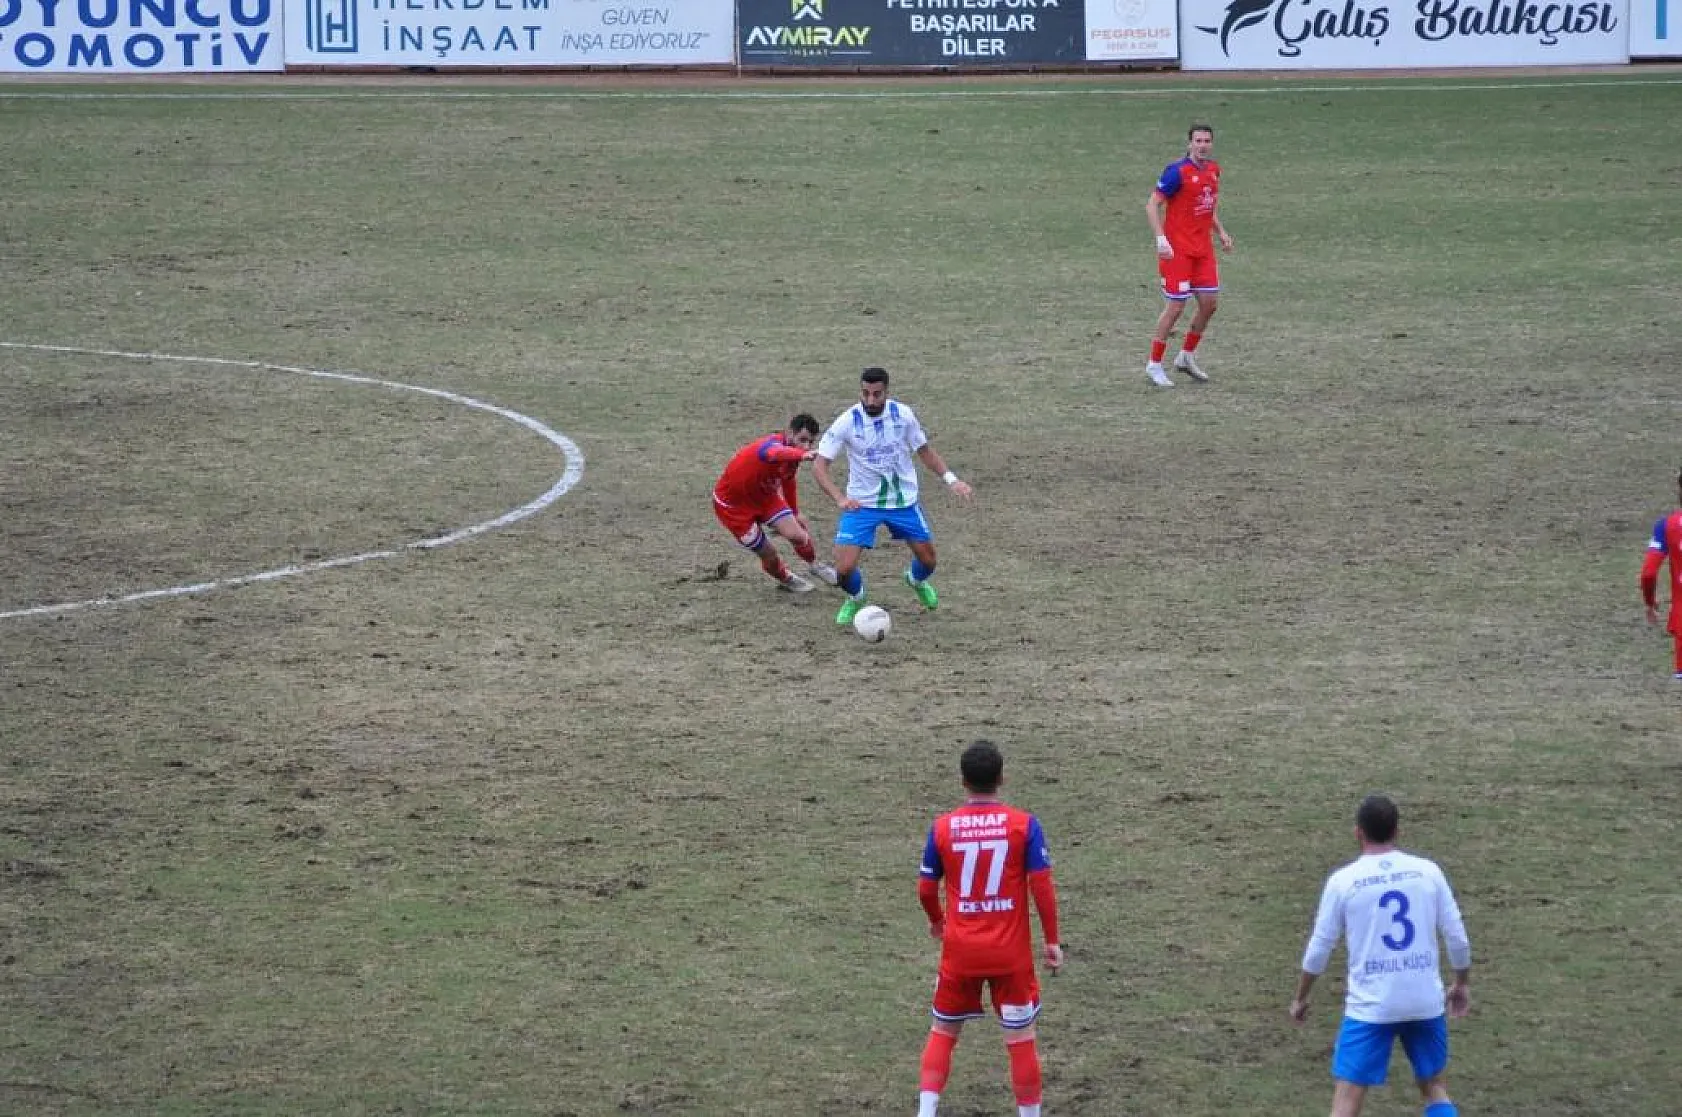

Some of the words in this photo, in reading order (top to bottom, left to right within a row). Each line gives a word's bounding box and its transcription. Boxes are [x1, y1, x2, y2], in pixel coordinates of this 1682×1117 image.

[602, 6, 670, 25] GÜVEN
[911, 14, 1036, 36] BAŞARILAR
[383, 20, 542, 57] İNŞAAT
[942, 34, 1006, 56] DİLER
[951, 813, 1007, 829] ESNAF
[952, 839, 1009, 898] 77
[1379, 890, 1415, 951] 3
